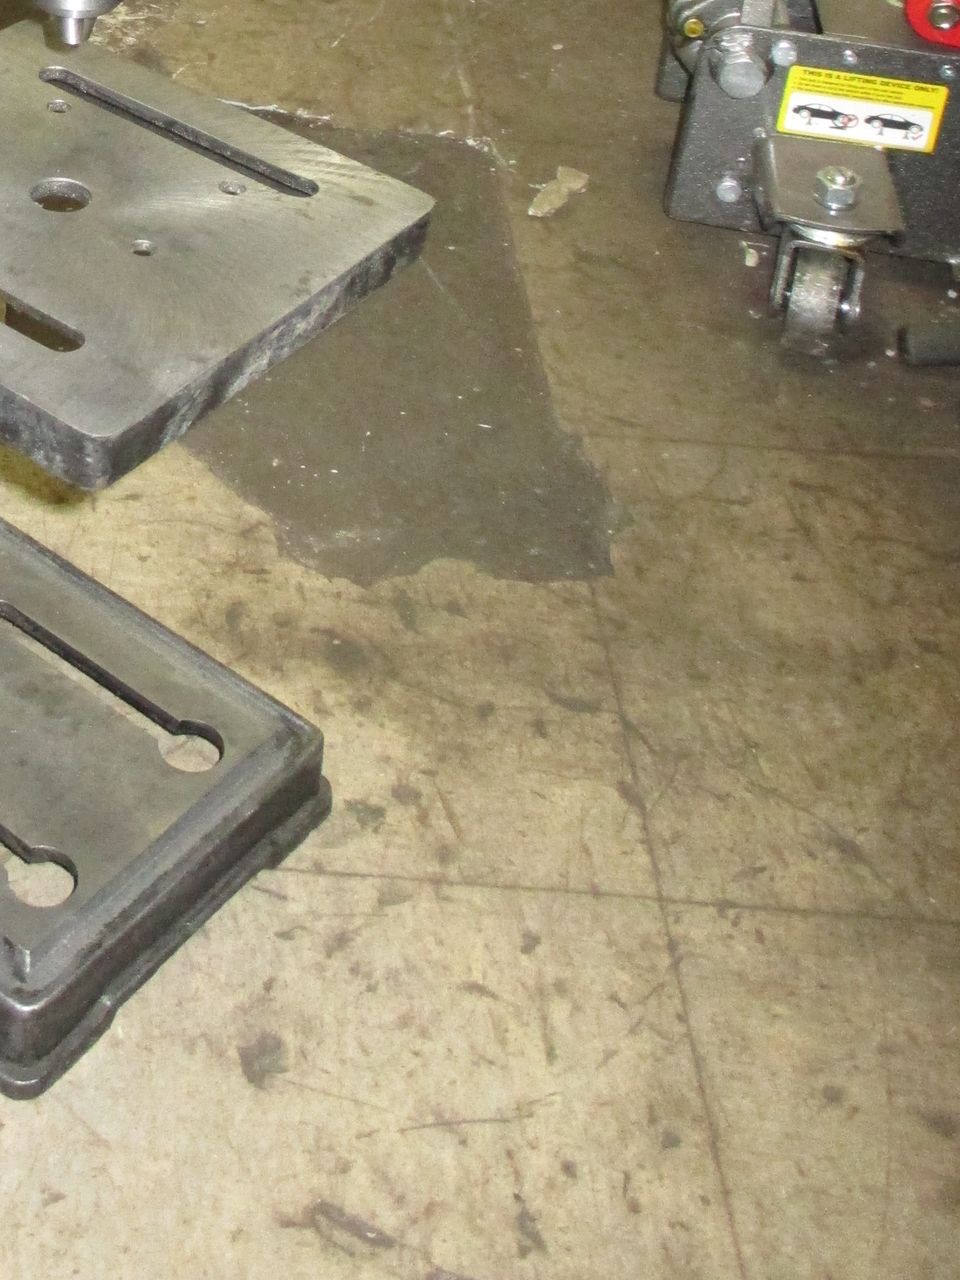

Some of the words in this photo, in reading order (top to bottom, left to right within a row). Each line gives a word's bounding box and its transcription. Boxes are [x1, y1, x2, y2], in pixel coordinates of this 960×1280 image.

[803, 68, 822, 77] THIS
[843, 74, 877, 85] LIFTING
[879, 79, 911, 90] DEVICE
